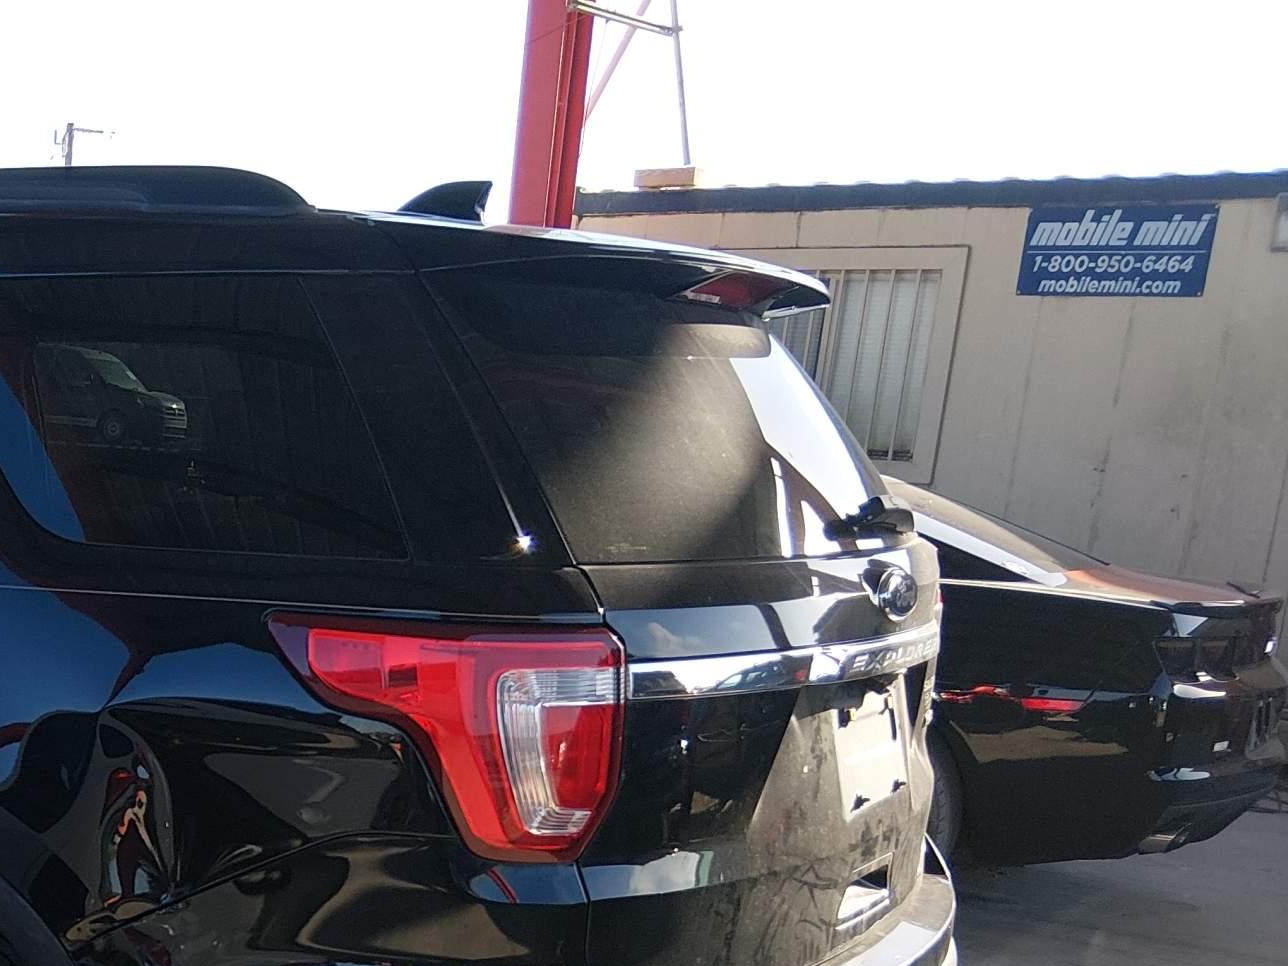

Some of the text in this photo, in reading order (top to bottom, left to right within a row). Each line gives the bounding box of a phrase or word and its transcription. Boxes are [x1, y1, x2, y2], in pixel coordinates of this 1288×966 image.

[1029, 209, 1214, 246] mobile mini
[1032, 255, 1195, 273] 1-800-950-6464
[1037, 276, 1181, 294] mobilemini.com
